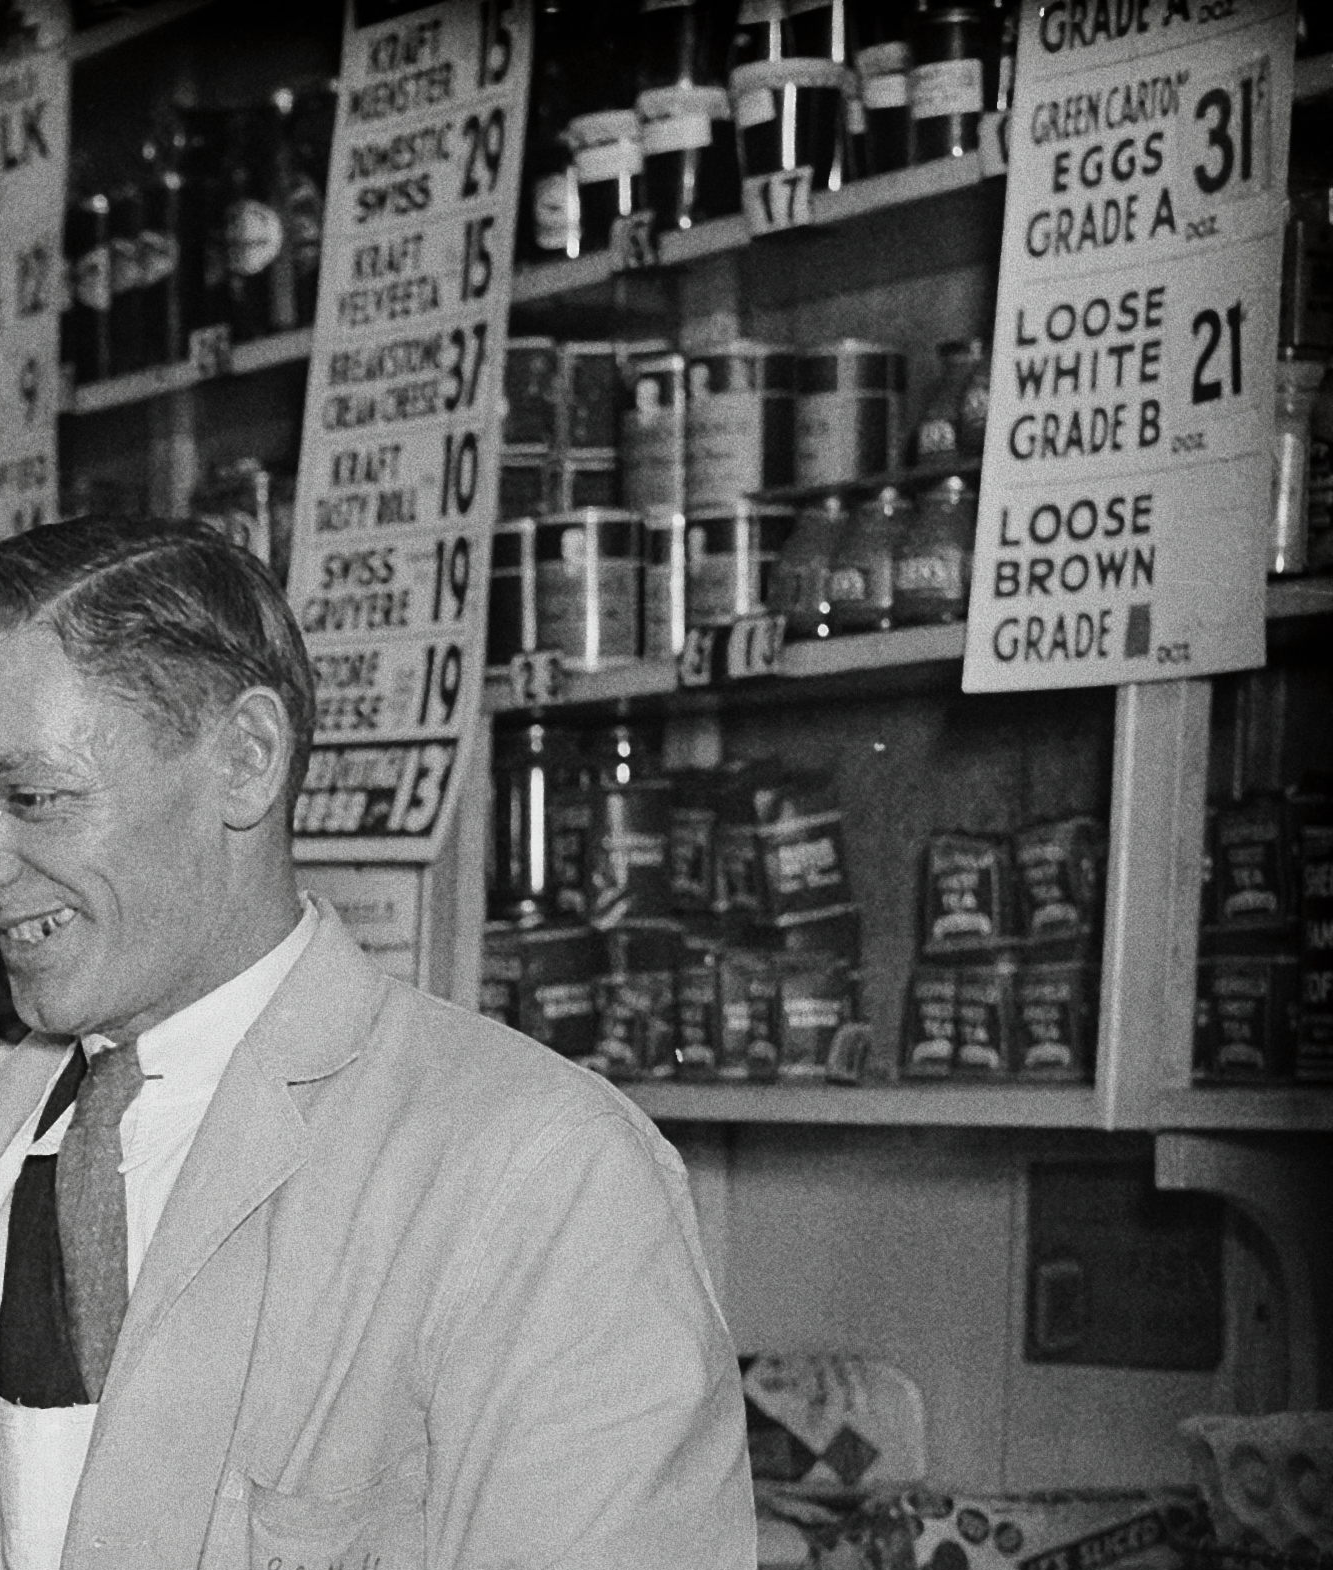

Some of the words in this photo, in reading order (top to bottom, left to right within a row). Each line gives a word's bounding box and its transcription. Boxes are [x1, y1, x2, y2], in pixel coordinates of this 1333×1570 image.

[367, 18, 444, 72] KRAFT
[1039, 0, 1150, 53] GRADE
[1031, 91, 1102, 145] GREEN
[347, 119, 453, 181] DOMESTIC
[460, 106, 506, 199] 29
[1052, 131, 1165, 194] EGGS
[355, 172, 433, 224] SWISS
[1025, 195, 1139, 259] GRADE
[1149, 186, 1177, 238] A
[353, 233, 425, 278] KRAFT
[461, 216, 495, 302] 15
[1015, 286, 1167, 347] LOOSE
[442, 321, 489, 411] 37
[1014, 339, 1162, 400] WHITE
[1190, 299, 1245, 405] 21
[1008, 402, 1127, 461] GRADE
[1139, 398, 1162, 448] B
[331, 442, 402, 484] KRAFT
[440, 432, 479, 517] 10
[1000, 493, 1154, 548] LOOSE
[321, 548, 396, 590] SWISS
[433, 536, 470, 622] 19
[993, 544, 1156, 598] BROWN
[992, 608, 1113, 662] GRADE
[417, 644, 464, 726] 19
[387, 745, 454, 832] 13
